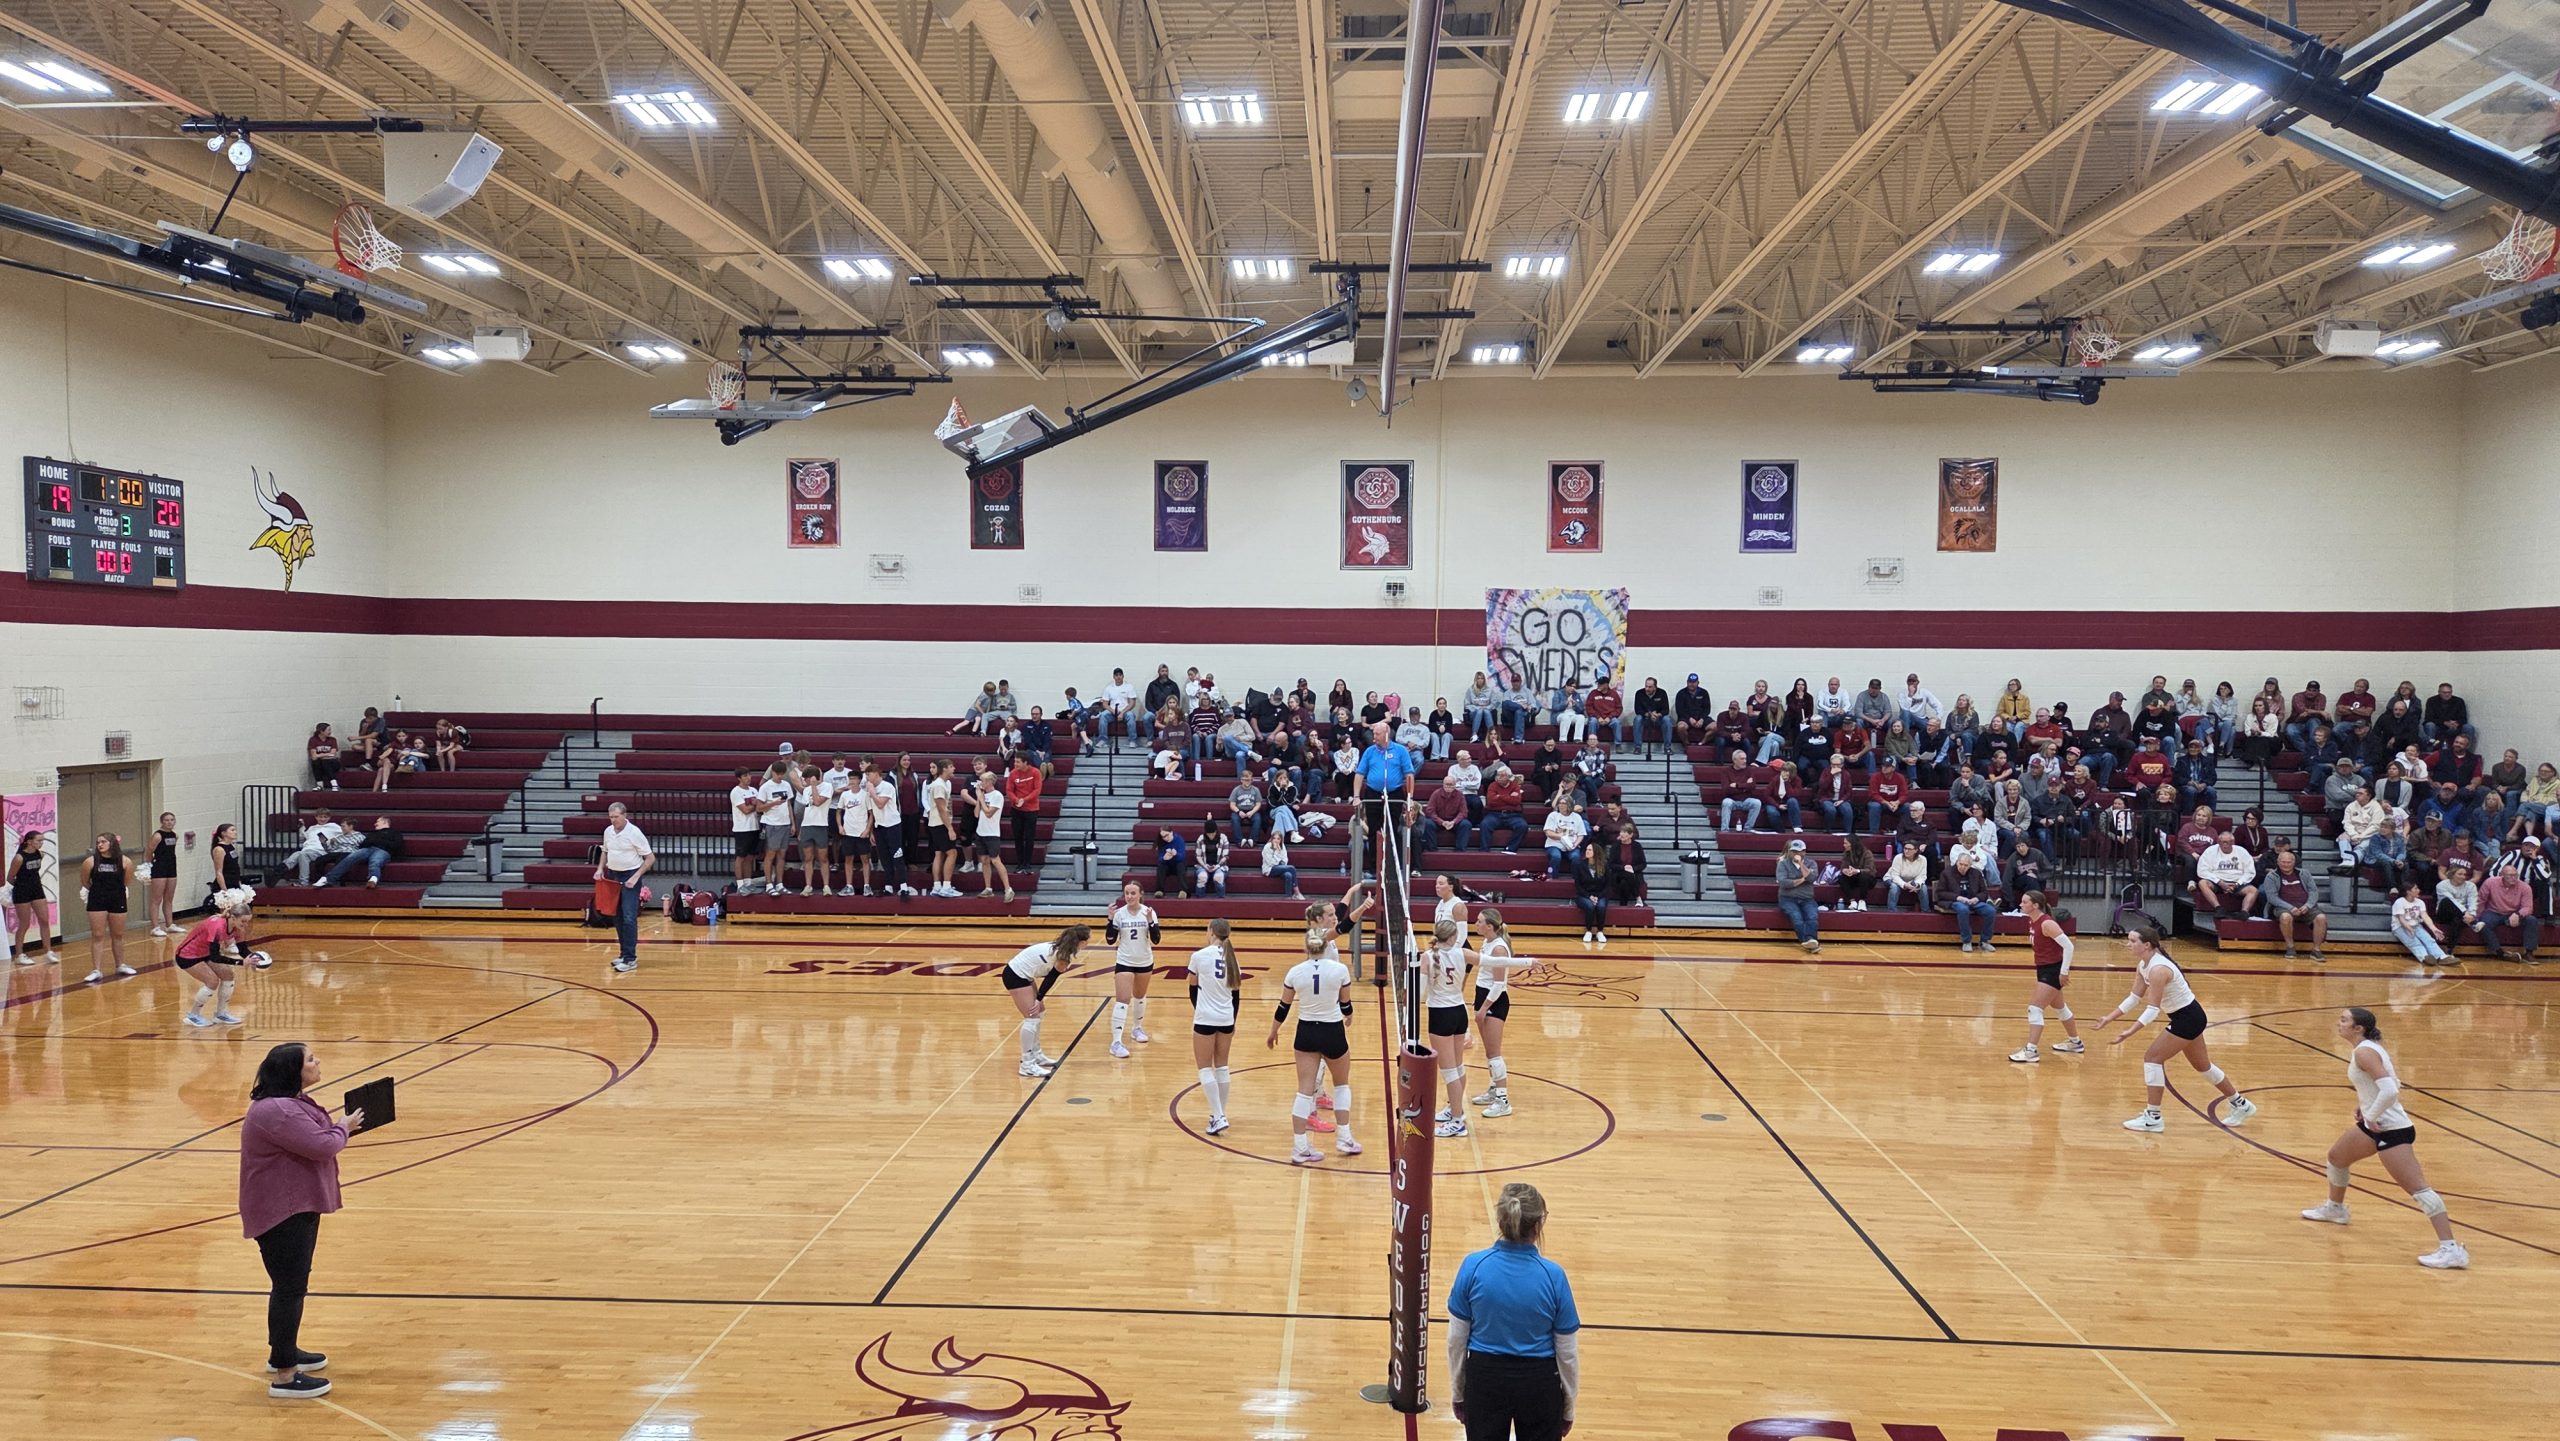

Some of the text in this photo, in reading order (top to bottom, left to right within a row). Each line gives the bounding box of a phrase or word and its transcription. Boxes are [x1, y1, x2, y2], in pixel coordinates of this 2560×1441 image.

[40, 465, 68, 480] HOME
[149, 481, 181, 497] VISITOR
[52, 485, 72, 513] 19
[99, 508, 113, 516] POSS
[157, 500, 181, 527] 20
[52, 517, 76, 528] BONUS
[94, 516, 119, 527] PERIOD
[122, 515, 131, 536] 3
[1352, 516, 1402, 524] GOTHENBURG
[48, 535, 71, 546] FOULS
[149, 529, 170, 539] BONUS
[91, 539, 142, 553] PLAYER FOULS
[154, 546, 174, 556] FOULS
[104, 574, 125, 583] MATCH
[1520, 607, 1587, 647] GO
[1489, 646, 1615, 692] SWEDES
[1130, 928, 1138, 940] 2
[1215, 959, 1226, 979] 5
[1445, 967, 1455, 985] 5
[1312, 974, 1320, 995] 1
[1392, 1158, 1410, 1391] SWEDES
[1417, 1213, 1429, 1405] GOTHENBURG
